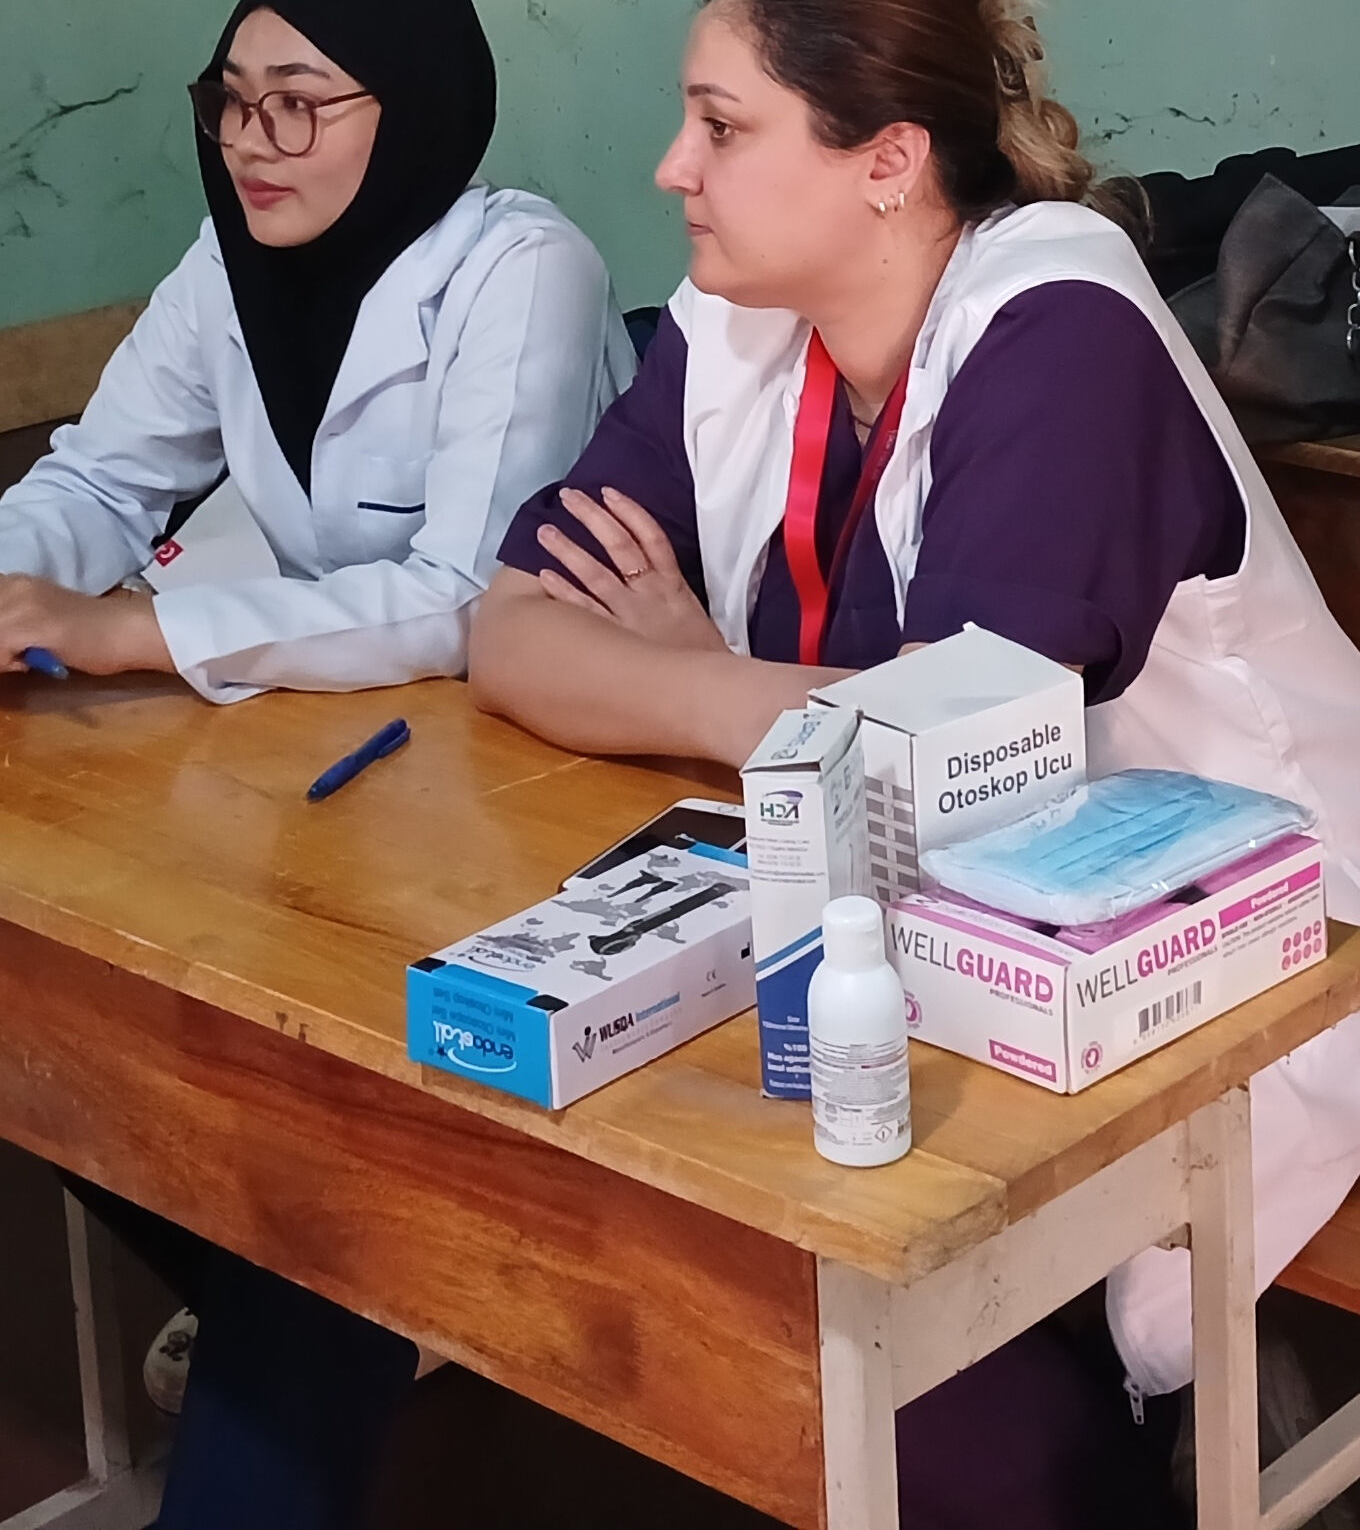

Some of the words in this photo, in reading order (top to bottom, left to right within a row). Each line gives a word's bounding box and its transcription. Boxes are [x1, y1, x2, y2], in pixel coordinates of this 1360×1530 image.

[946, 723, 1062, 780] Disposable
[938, 770, 1028, 814] Otoskop
[1034, 752, 1073, 780] Ucu
[890, 922, 1055, 1004] WELLGUARD
[1076, 918, 1217, 1008] WELLGUARD
[993, 1043, 1053, 1077] Powdered
